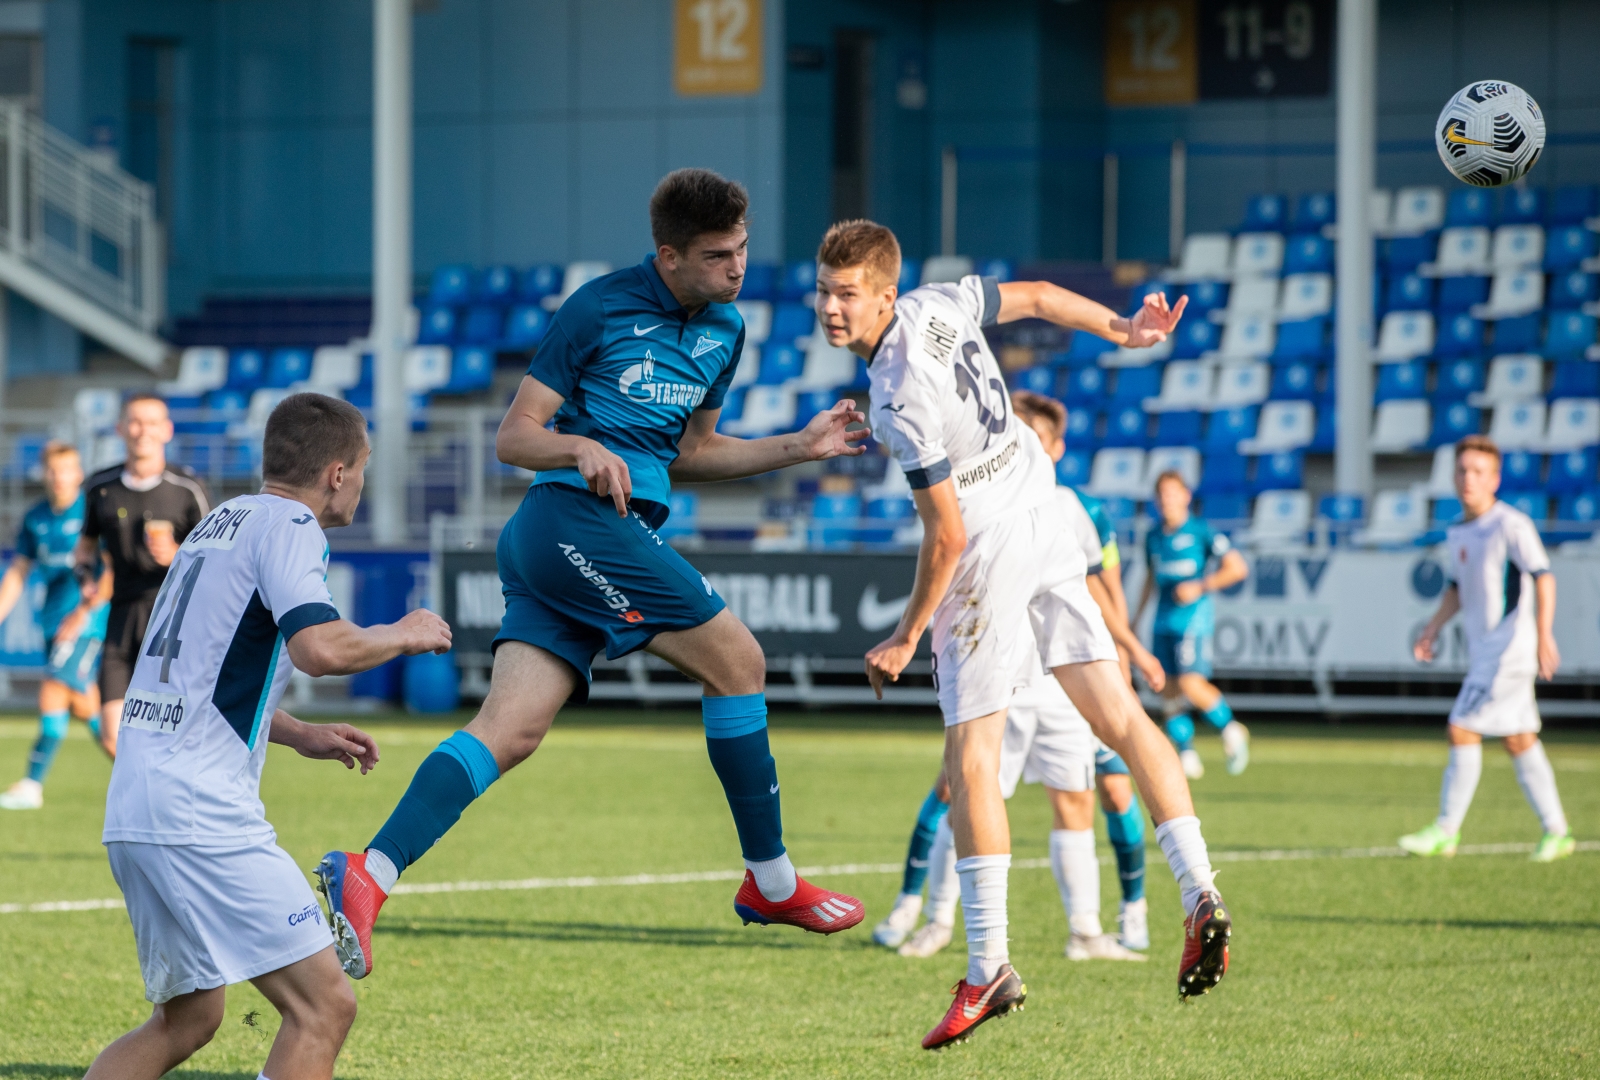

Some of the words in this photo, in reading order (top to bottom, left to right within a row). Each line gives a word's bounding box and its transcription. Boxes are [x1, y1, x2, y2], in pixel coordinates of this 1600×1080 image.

[689, 0, 748, 58] 12
[1125, 7, 1181, 70] 12
[1218, 3, 1313, 60] 11-9
[1213, 616, 1331, 664] OMV
